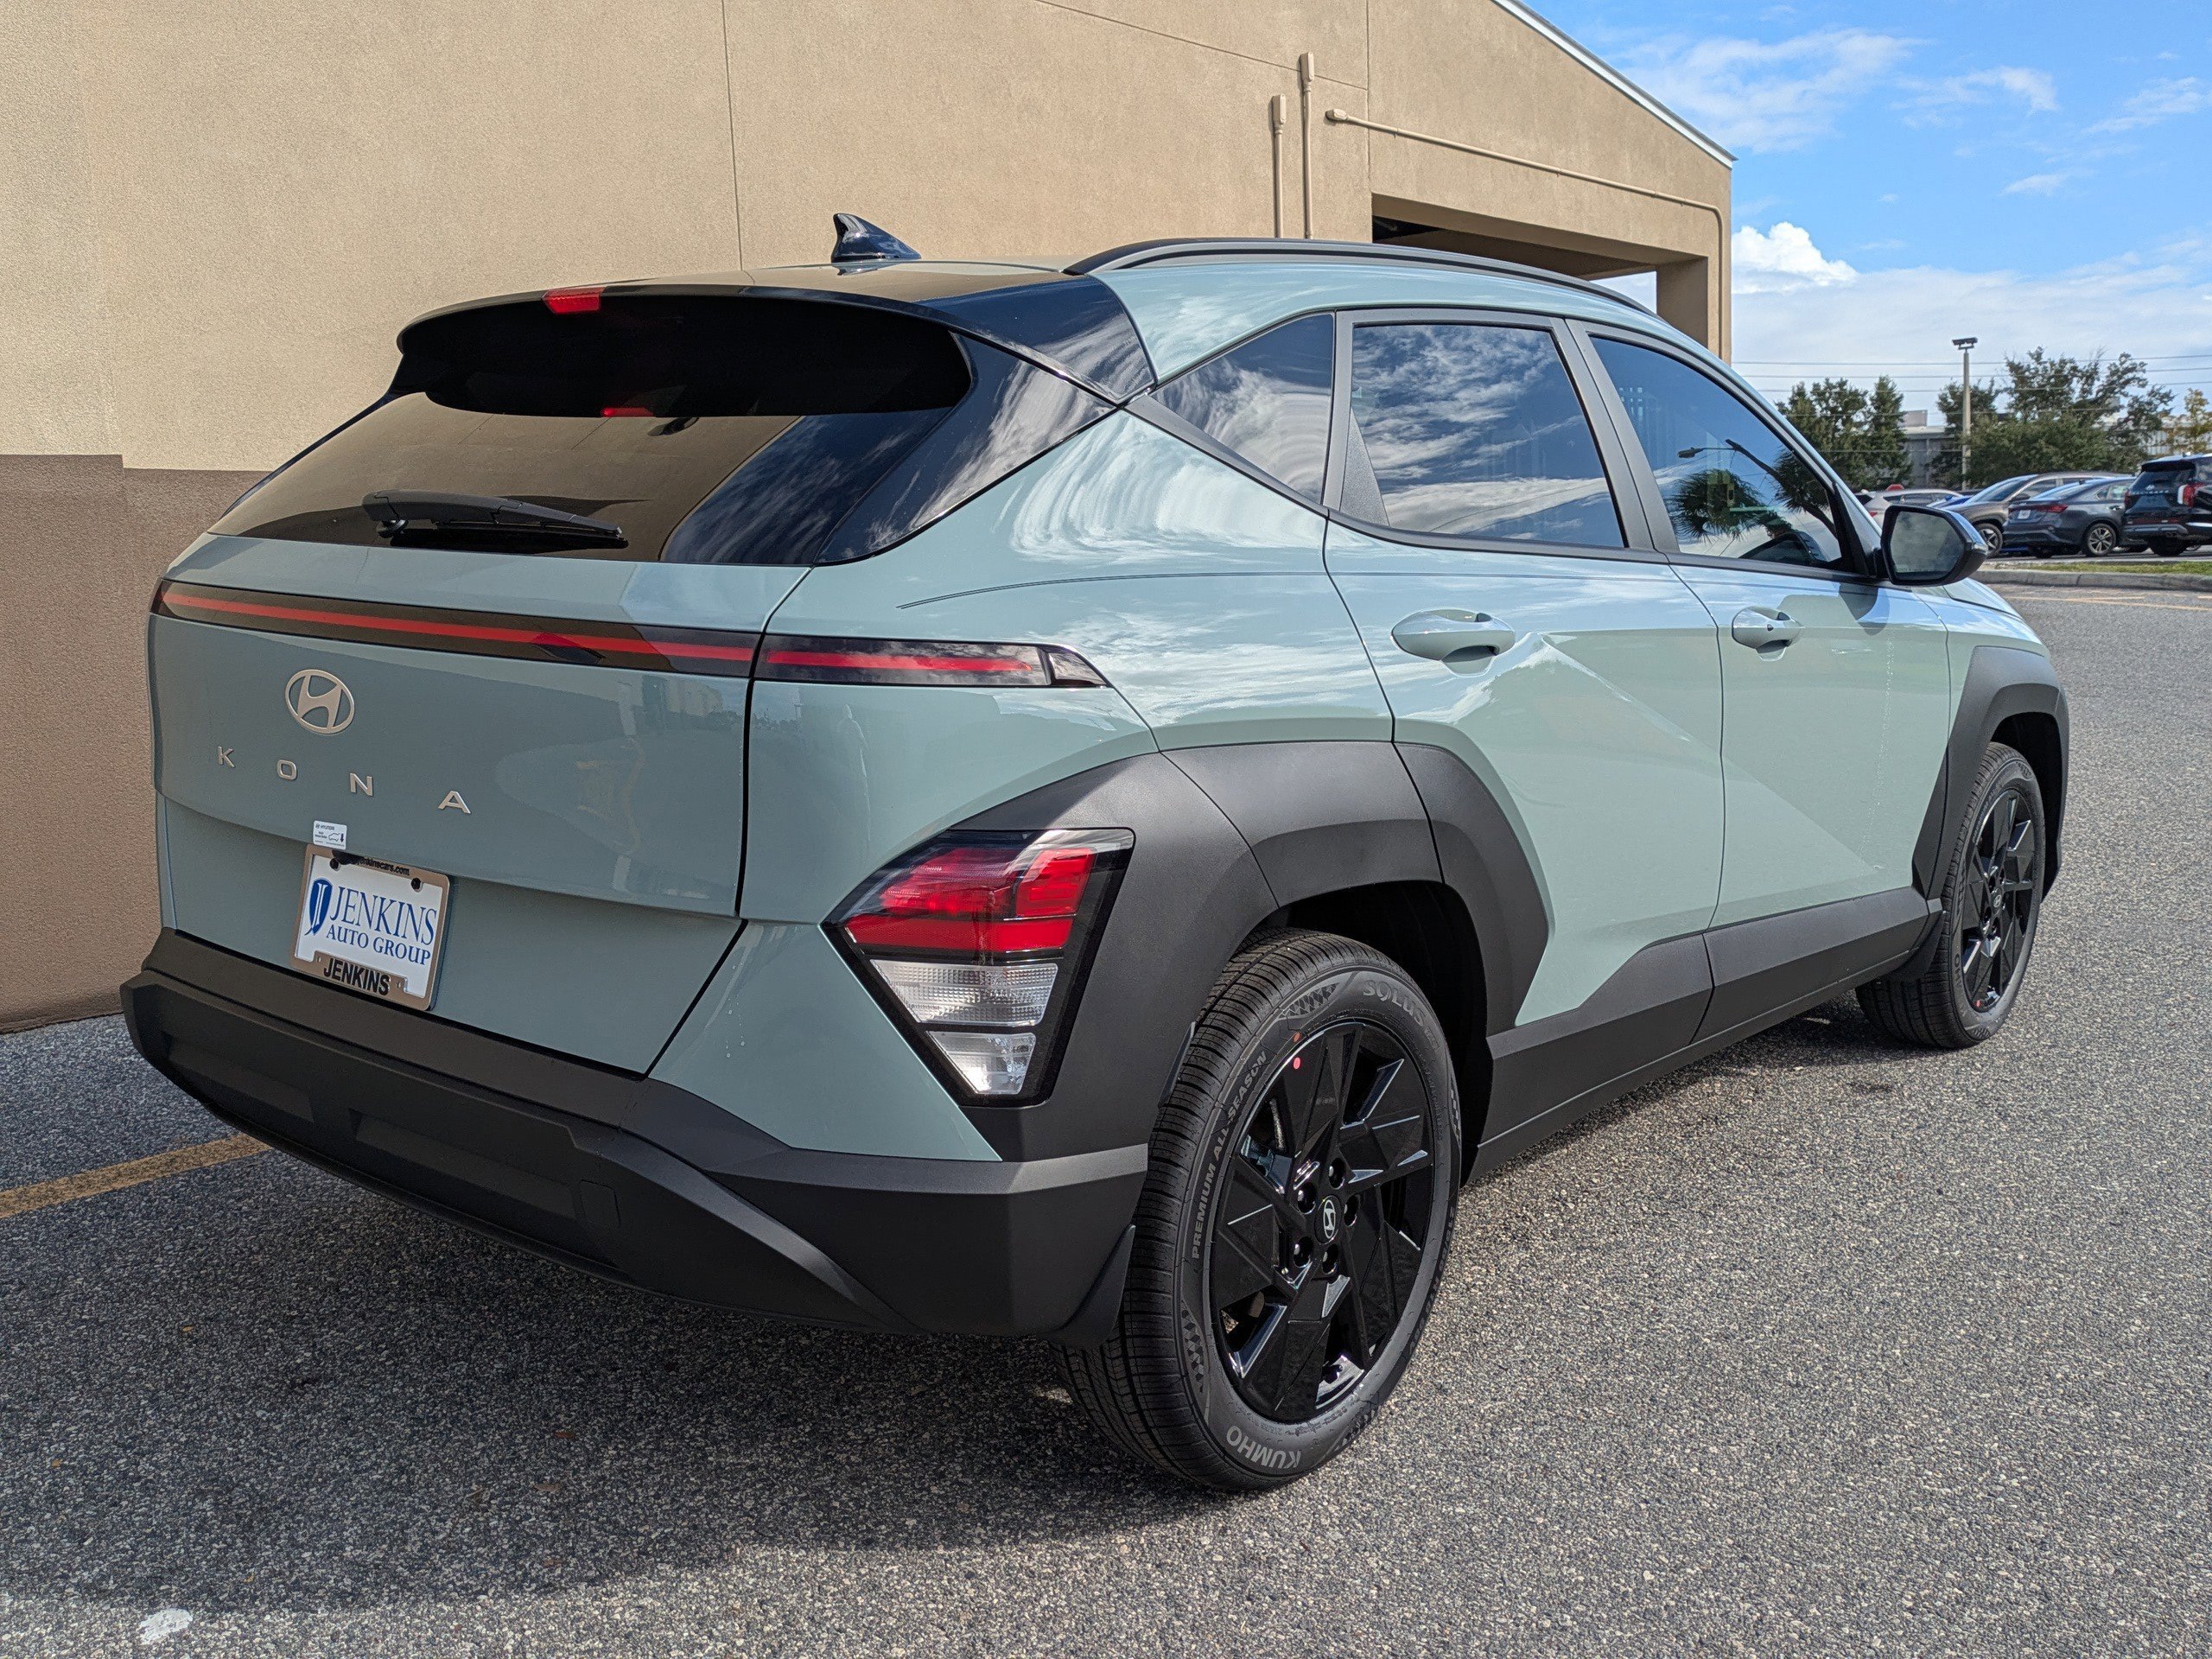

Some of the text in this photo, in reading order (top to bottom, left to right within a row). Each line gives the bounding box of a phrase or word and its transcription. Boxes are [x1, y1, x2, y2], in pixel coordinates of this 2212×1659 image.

[218, 746, 472, 815] KONA
[329, 886, 437, 945] JENKINS
[326, 924, 431, 965] AUTO GROUP
[323, 958, 391, 996] JENKINS
[1363, 979, 1426, 1027] SOLUS
[1192, 1163, 1217, 1259] PREMIUM
[1225, 1425, 1302, 1469] KUMHO
